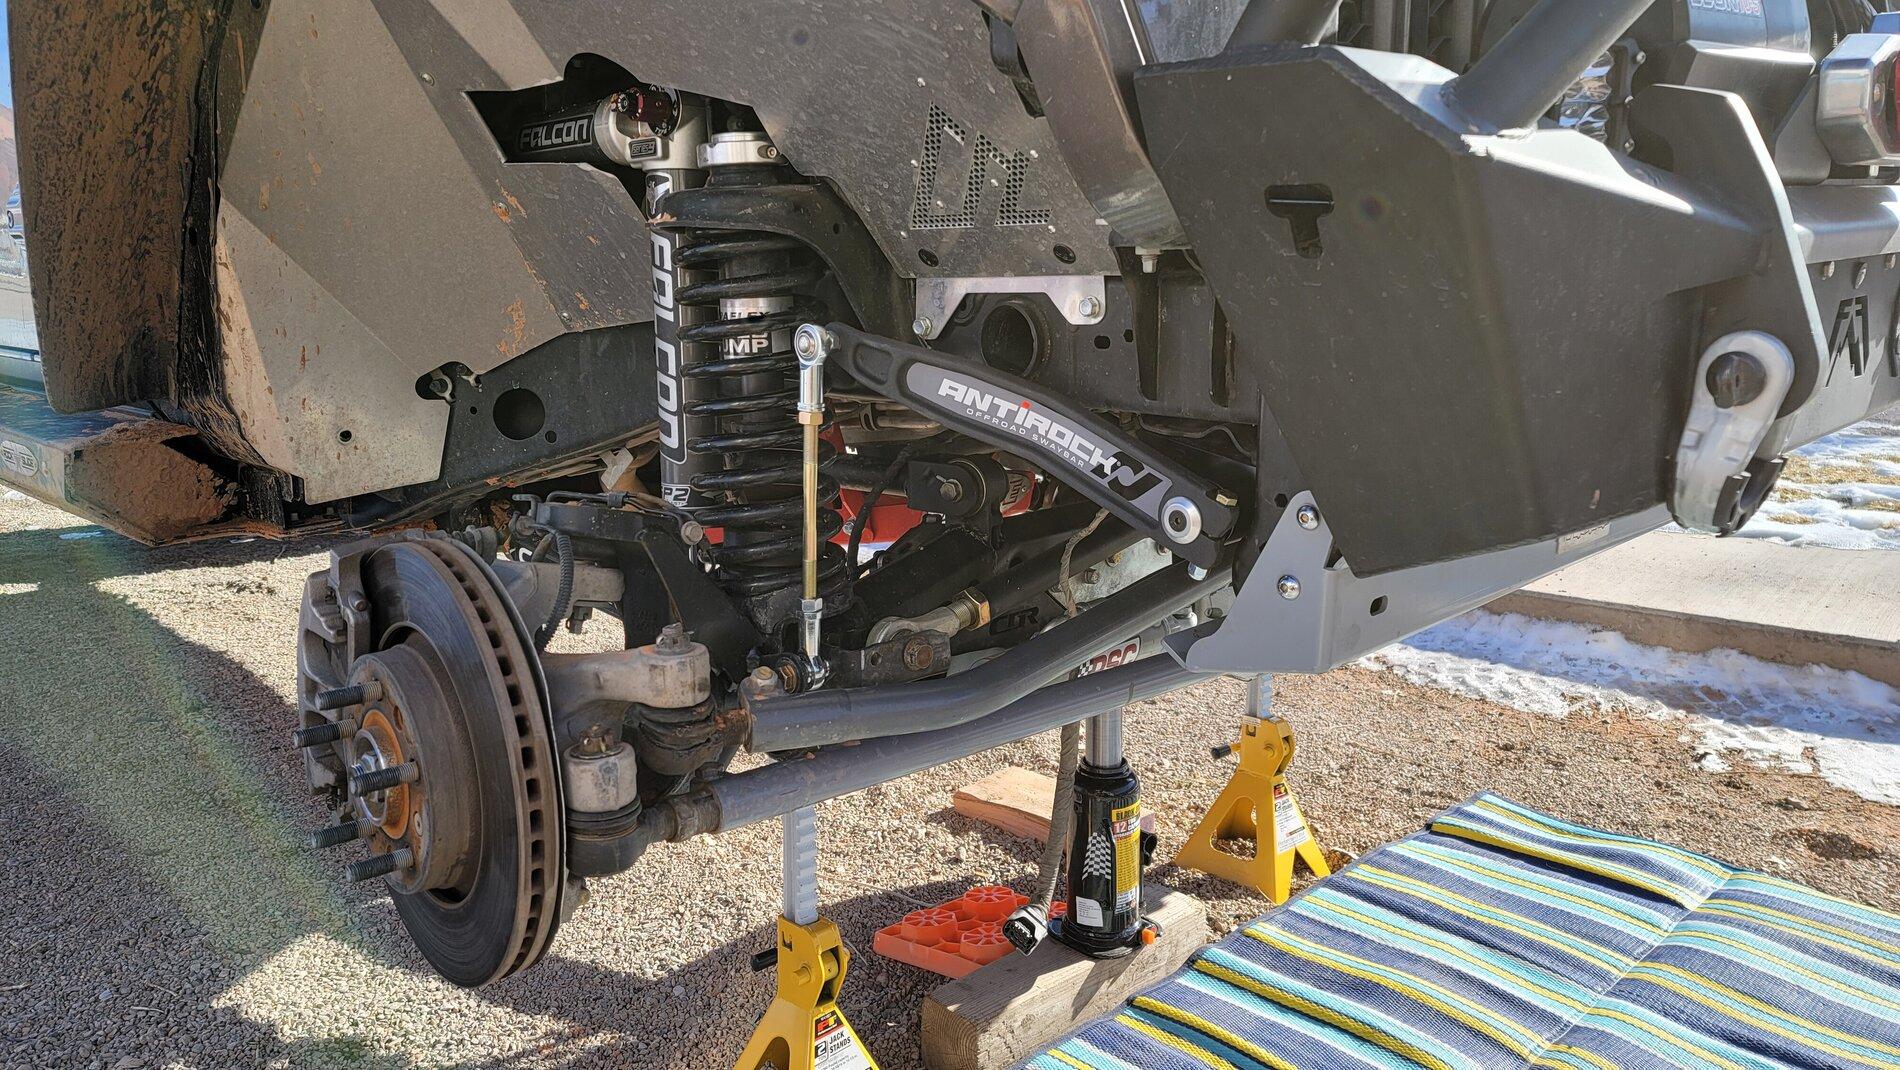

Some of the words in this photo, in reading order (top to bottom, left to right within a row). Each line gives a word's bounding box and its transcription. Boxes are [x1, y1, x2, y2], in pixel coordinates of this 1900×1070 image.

[520, 119, 589, 150] FALCON
[651, 232, 679, 449] FALCON
[966, 408, 1026, 435] OFFROAD
[1032, 433, 1085, 468] SWAYBAR
[829, 1031, 845, 1044] JACK
[829, 1037, 851, 1053] STANDS
